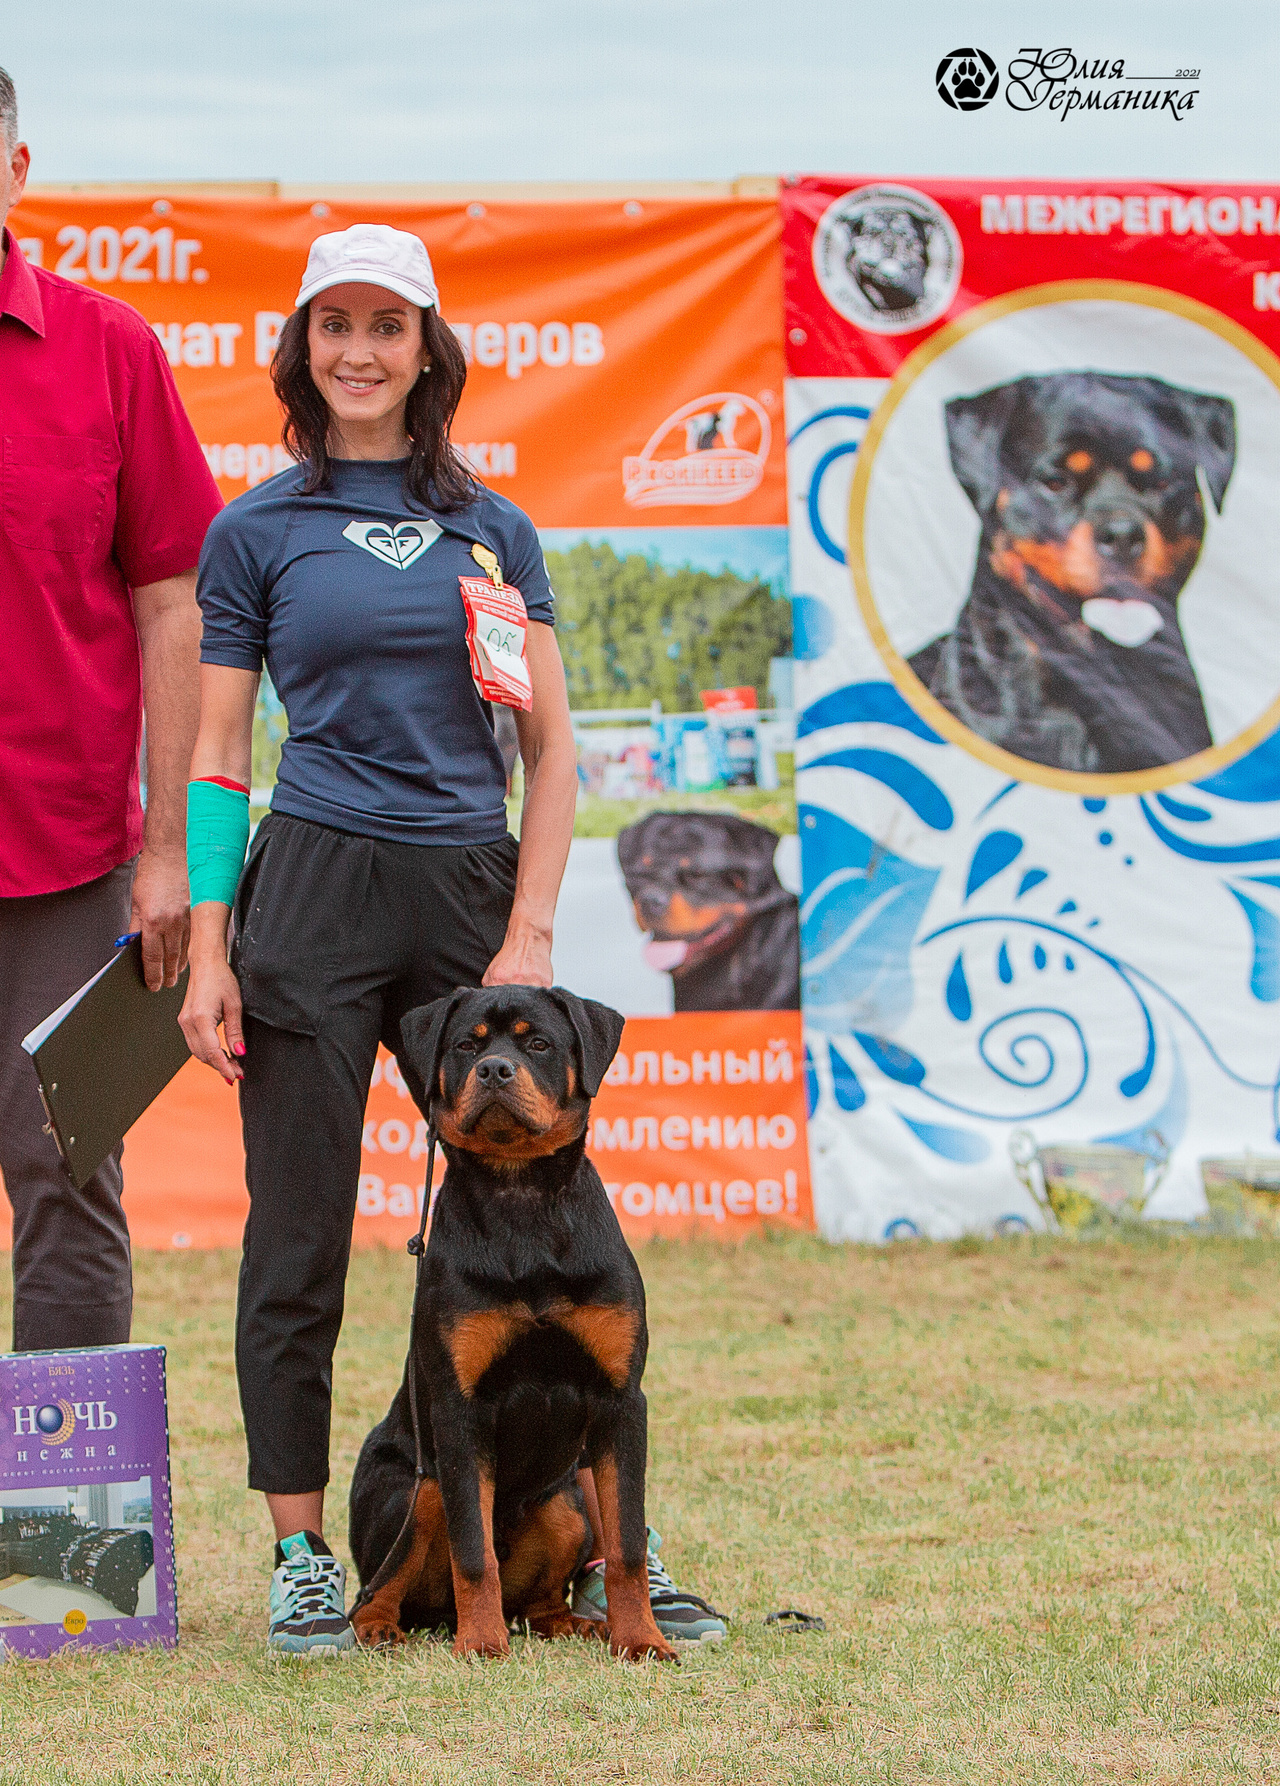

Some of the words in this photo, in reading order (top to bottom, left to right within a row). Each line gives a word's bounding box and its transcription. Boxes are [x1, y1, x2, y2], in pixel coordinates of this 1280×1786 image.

[981, 194, 1280, 235] МЕЖРЕГИОН
[55, 225, 210, 284] 2021г.
[48, 1365, 75, 1376] БЯЗЬ
[17, 1445, 116, 1462] нежна
